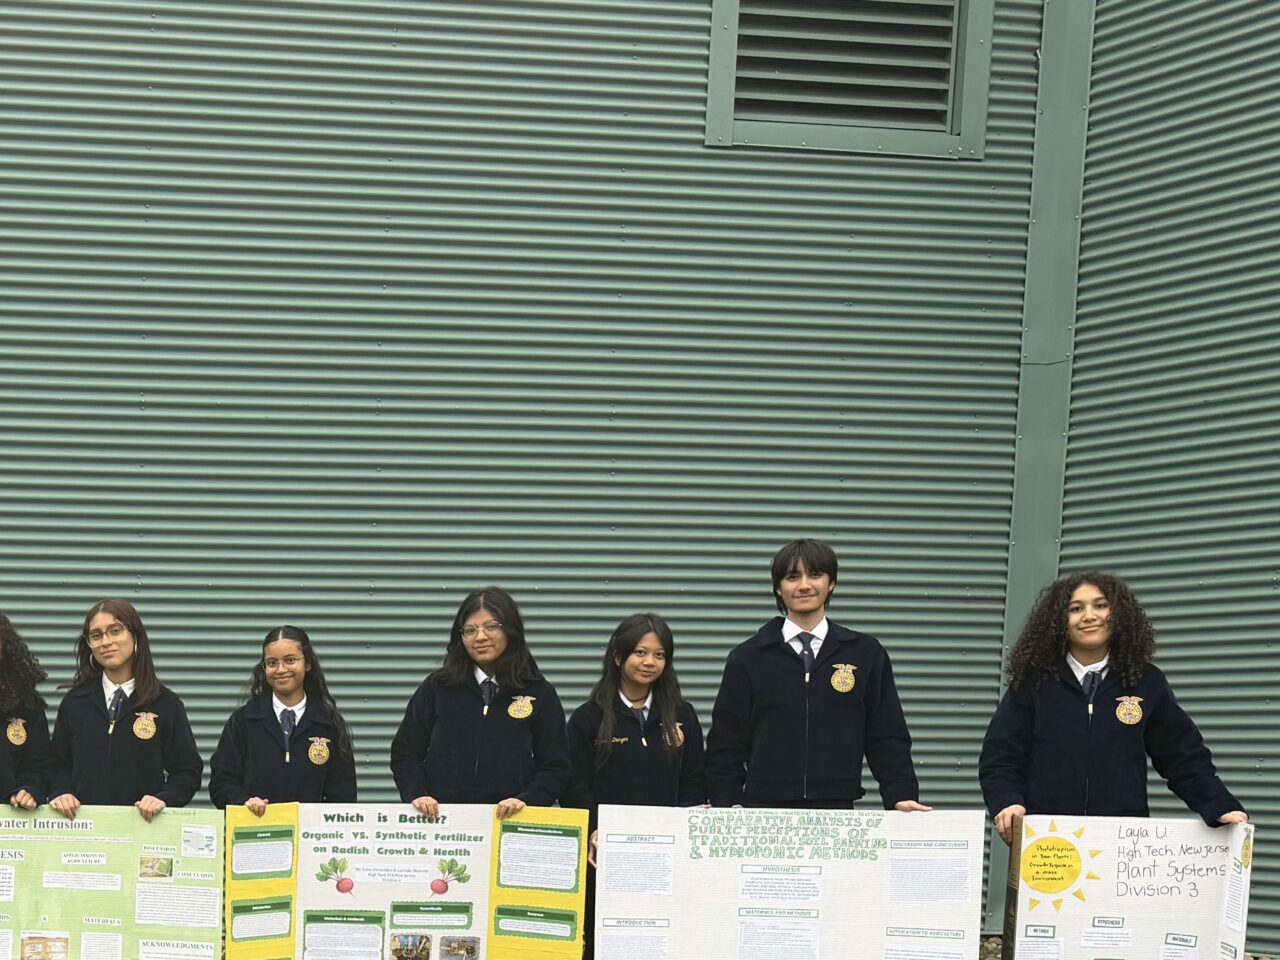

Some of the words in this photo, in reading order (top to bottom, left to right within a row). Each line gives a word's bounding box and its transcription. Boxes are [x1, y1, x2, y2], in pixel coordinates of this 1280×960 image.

[33, 818, 93, 830] Intrusion:
[323, 812, 364, 823] Which
[378, 813, 388, 822] is
[399, 814, 447, 824] Better?
[688, 815, 793, 827] COMPARATIVE
[797, 816, 862, 827] ANALYSIS
[866, 818, 882, 828] OF
[302, 831, 345, 841] Organic
[375, 831, 427, 841] Synthetic
[434, 833, 484, 842] Fertilizer
[688, 825, 742, 836] PUBLIC
[746, 827, 841, 838] PERCEPTIONS
[848, 828, 870, 839] OF
[1118, 825, 1149, 845] Layla
[689, 834, 796, 846] TRADITIONAL
[798, 836, 829, 846] SOIL
[833, 838, 887, 849] FARMING
[332, 846, 369, 855] Radish
[377, 847, 415, 856] Growth
[419, 847, 428, 855] &
[434, 848, 471, 856] Health
[689, 846, 703, 860] &
[708, 846, 805, 859] HYDROPONIC
[808, 847, 879, 861] METHODS
[1118, 845, 1142, 862] High
[1116, 859, 1159, 880] Plant
[1166, 860, 1227, 882] Systems
[1116, 881, 1181, 897] Division
[1187, 882, 1199, 897] 3
[142, 941, 213, 950] ACKNOWLEDGMENTS
